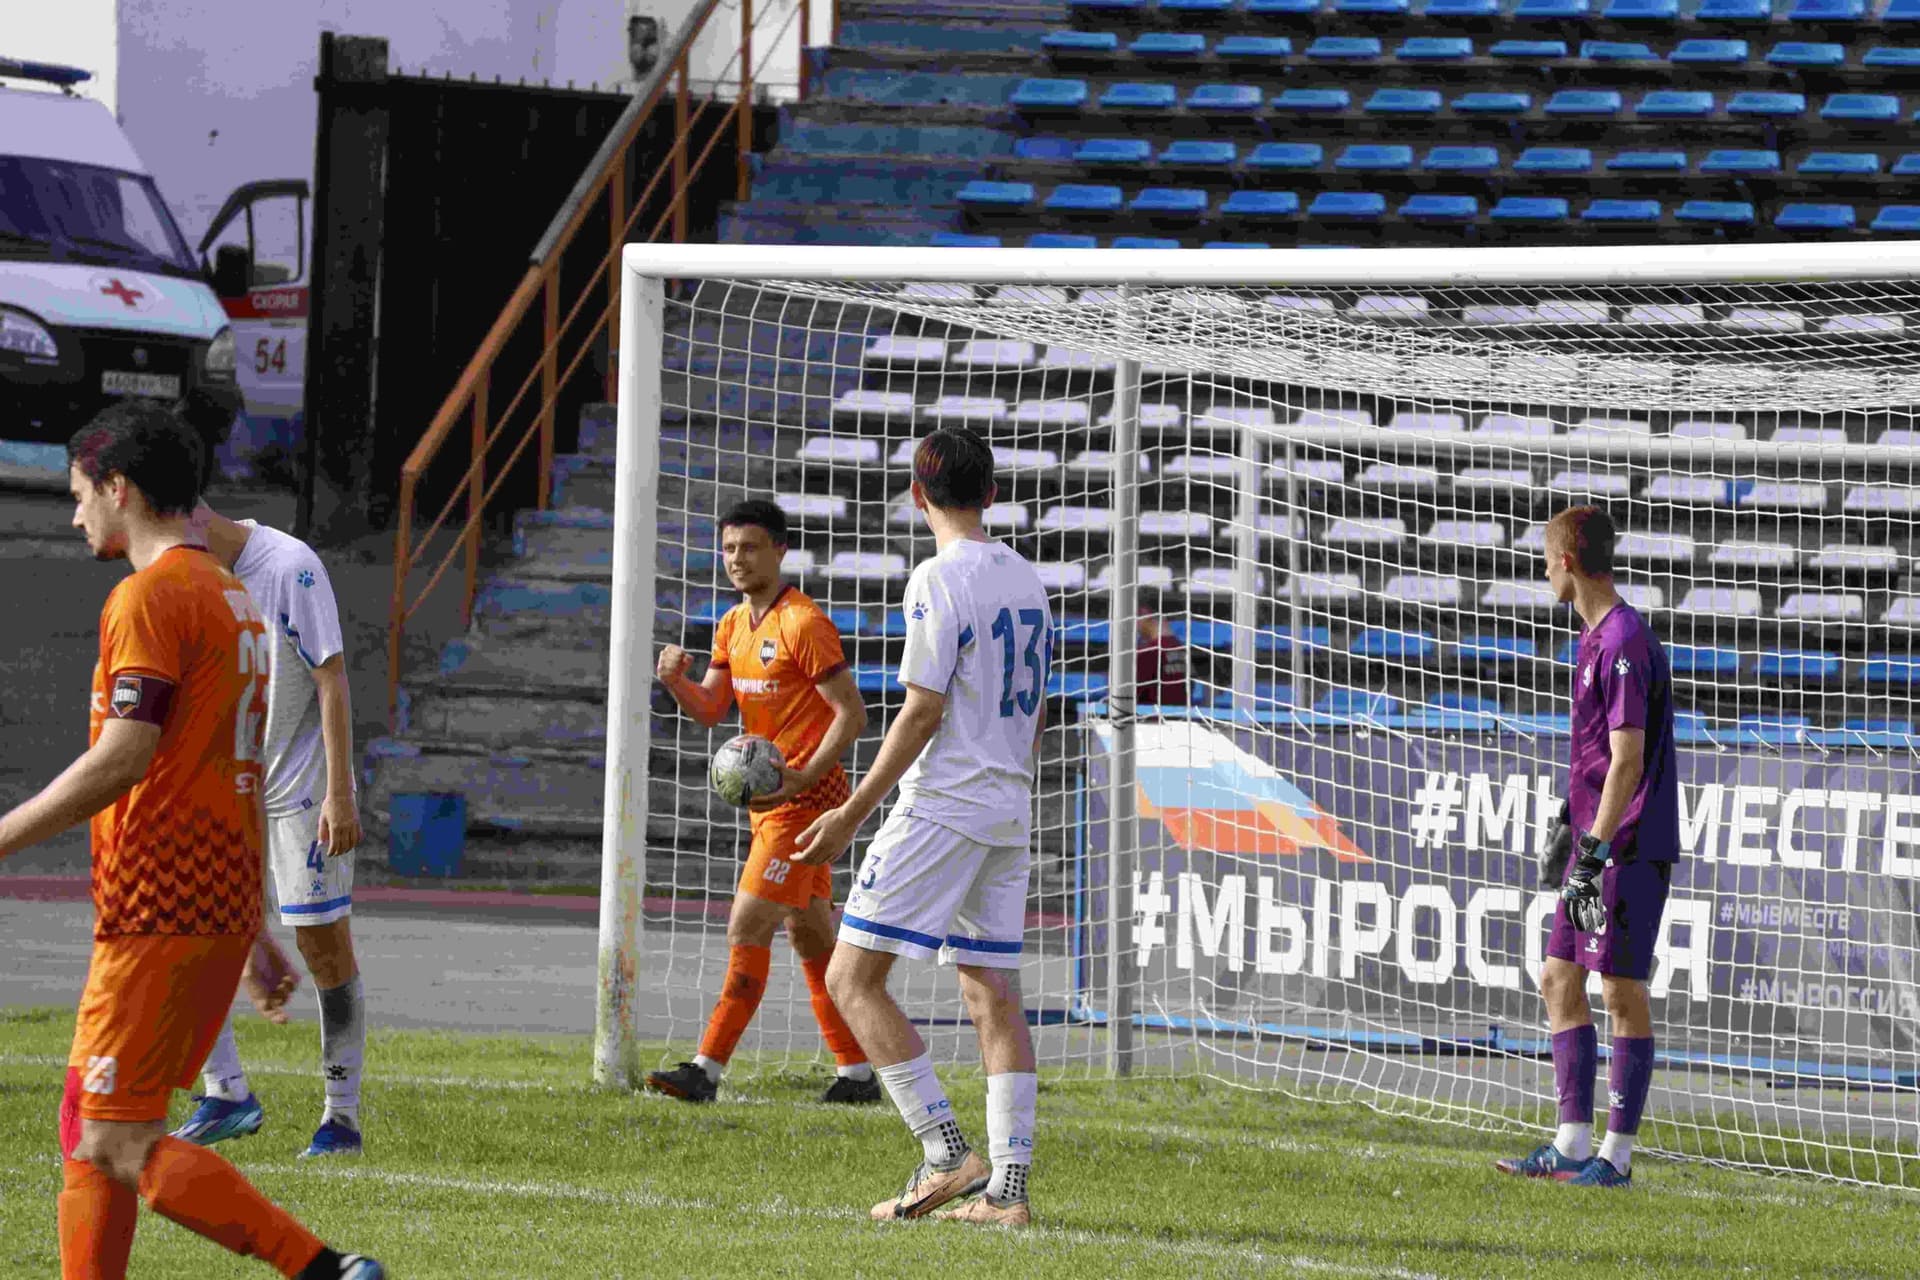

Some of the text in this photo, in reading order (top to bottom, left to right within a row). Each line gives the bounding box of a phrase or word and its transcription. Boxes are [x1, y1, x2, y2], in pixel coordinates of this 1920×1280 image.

[255, 338, 287, 374] 54
[991, 607, 1044, 718] 13
[307, 840, 325, 874] 4
[763, 858, 791, 884] 22
[1720, 902, 1851, 931] #МЫВМЕСТЕ
[83, 1055, 116, 1094] 23
[926, 1100, 949, 1115] FC
[1008, 1136, 1032, 1148] FC
